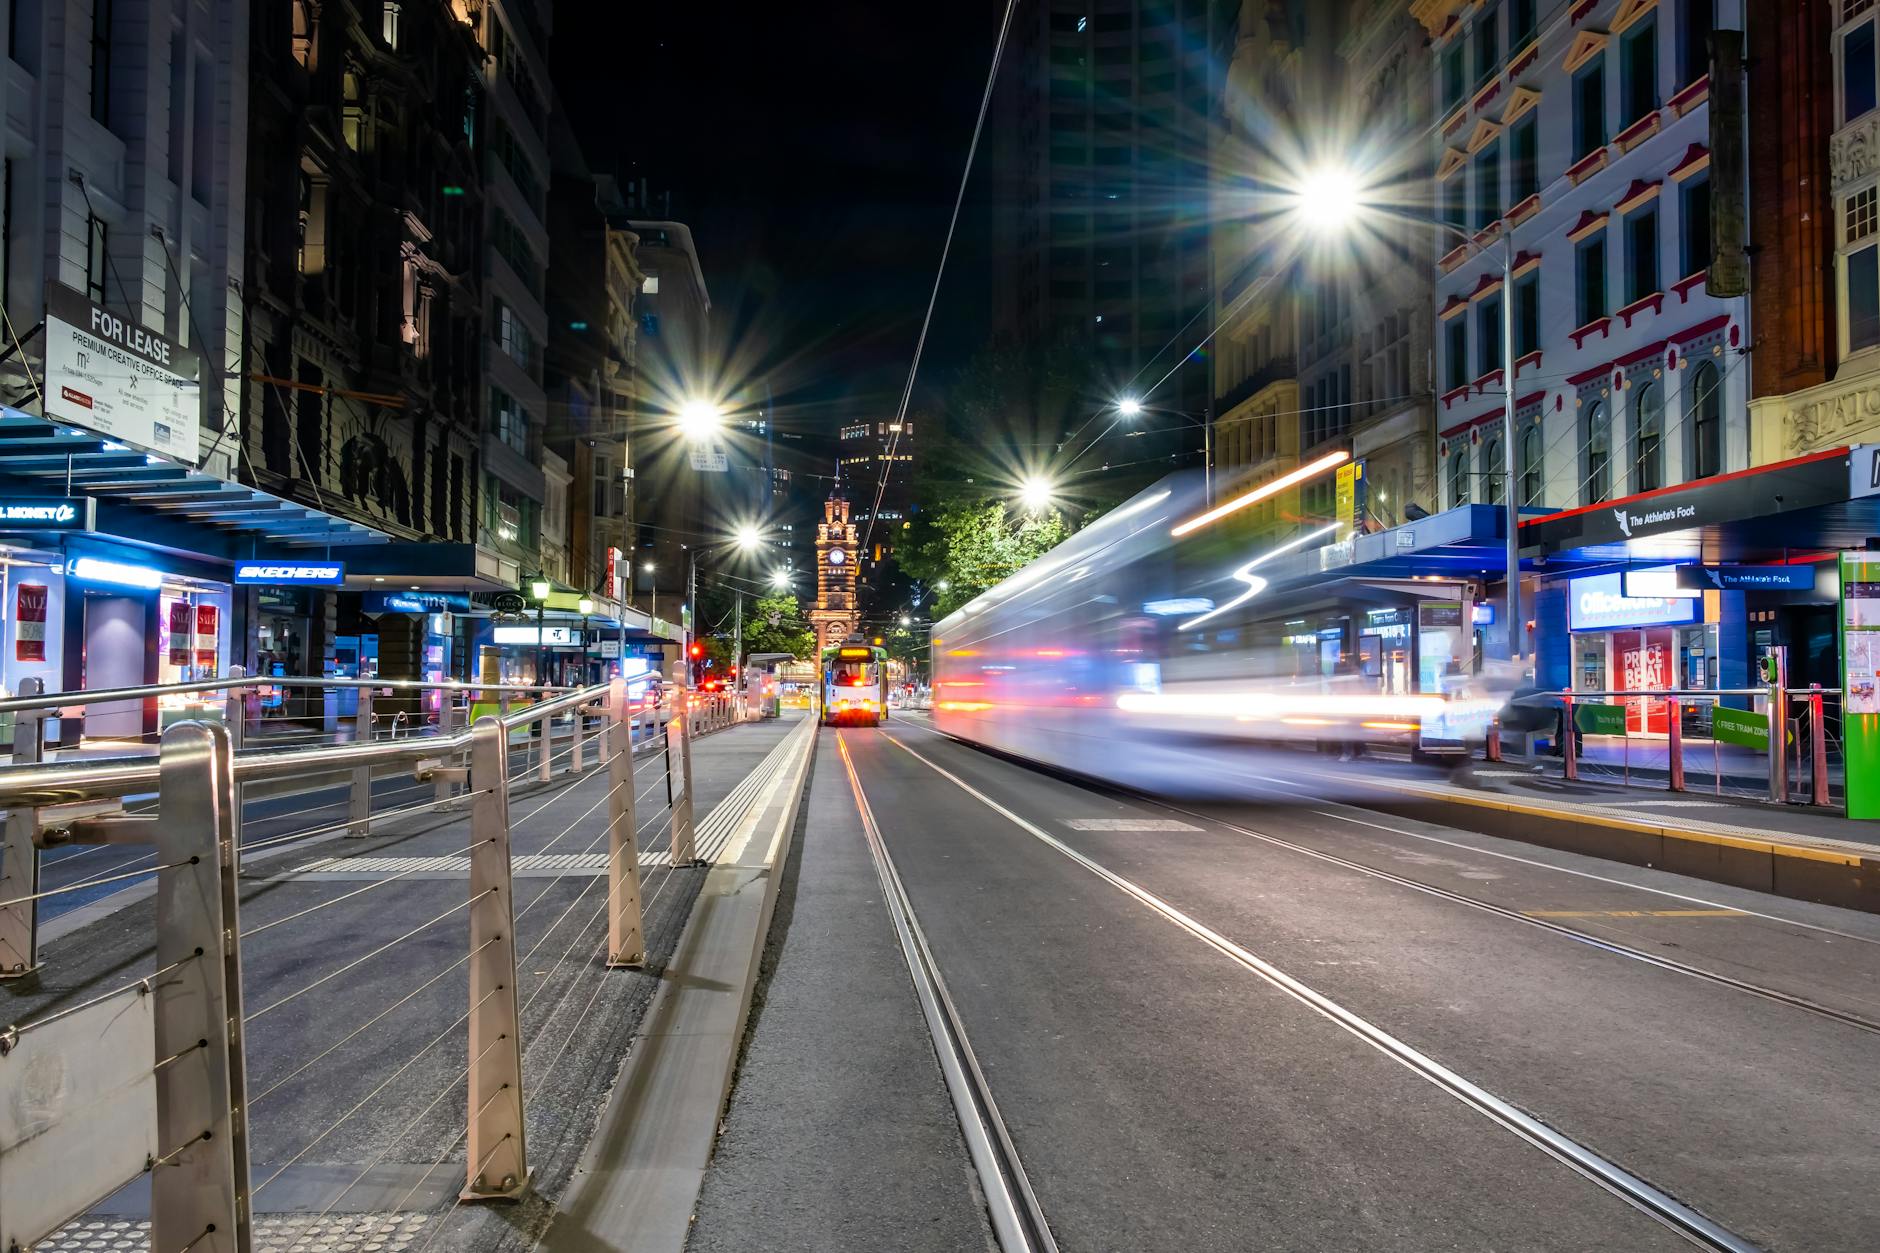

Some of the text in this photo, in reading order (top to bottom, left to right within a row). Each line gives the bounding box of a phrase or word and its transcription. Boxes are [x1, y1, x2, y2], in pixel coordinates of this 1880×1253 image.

[91, 307, 170, 365] FOR LEASE
[72, 331, 184, 390] PREMIUM CREATIVE OFFICE SPACE
[7, 507, 57, 519] MONEY
[1630, 505, 1695, 527] The Athlete's Foot
[238, 567, 340, 578] SKECHERS
[1723, 575, 1738, 583] The
[1773, 575, 1790, 583] Foot
[1624, 646, 1662, 669] PRCE
[1720, 720, 1768, 737] FREE TRAM ZONE
